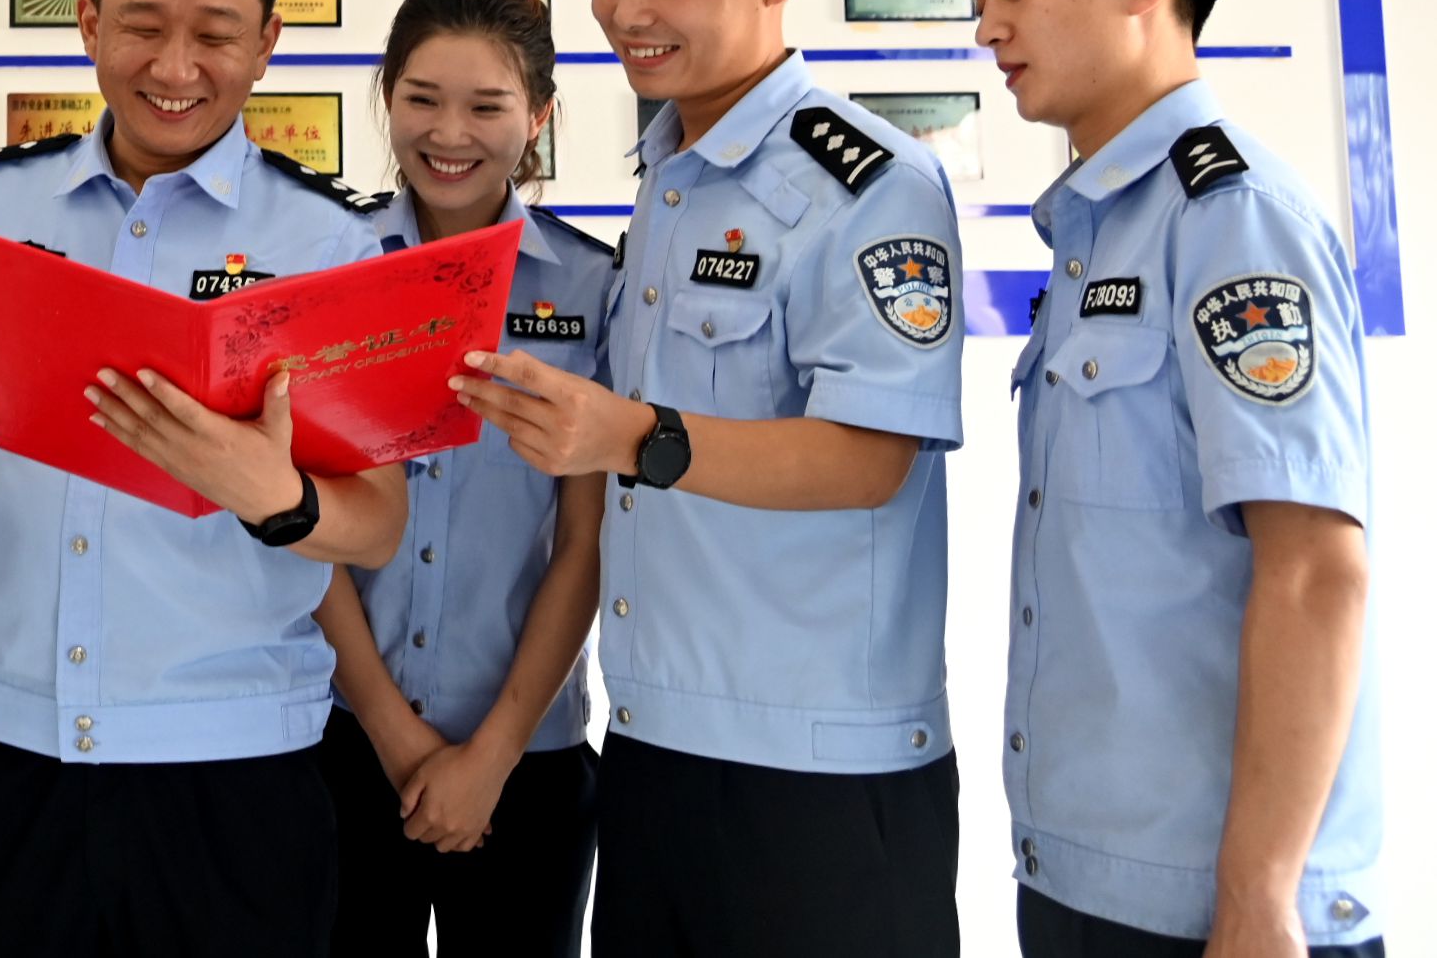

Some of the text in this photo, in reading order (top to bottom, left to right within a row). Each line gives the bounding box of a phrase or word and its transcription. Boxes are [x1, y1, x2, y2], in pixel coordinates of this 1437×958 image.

[863, 241, 946, 269] 中华人民共和国
[697, 256, 754, 281] 074227
[1084, 285, 1136, 309] FJ8093
[1197, 280, 1301, 324] 中华人民共和国
[513, 319, 580, 334] 176639
[354, 338, 450, 370] CREDENTIAL
